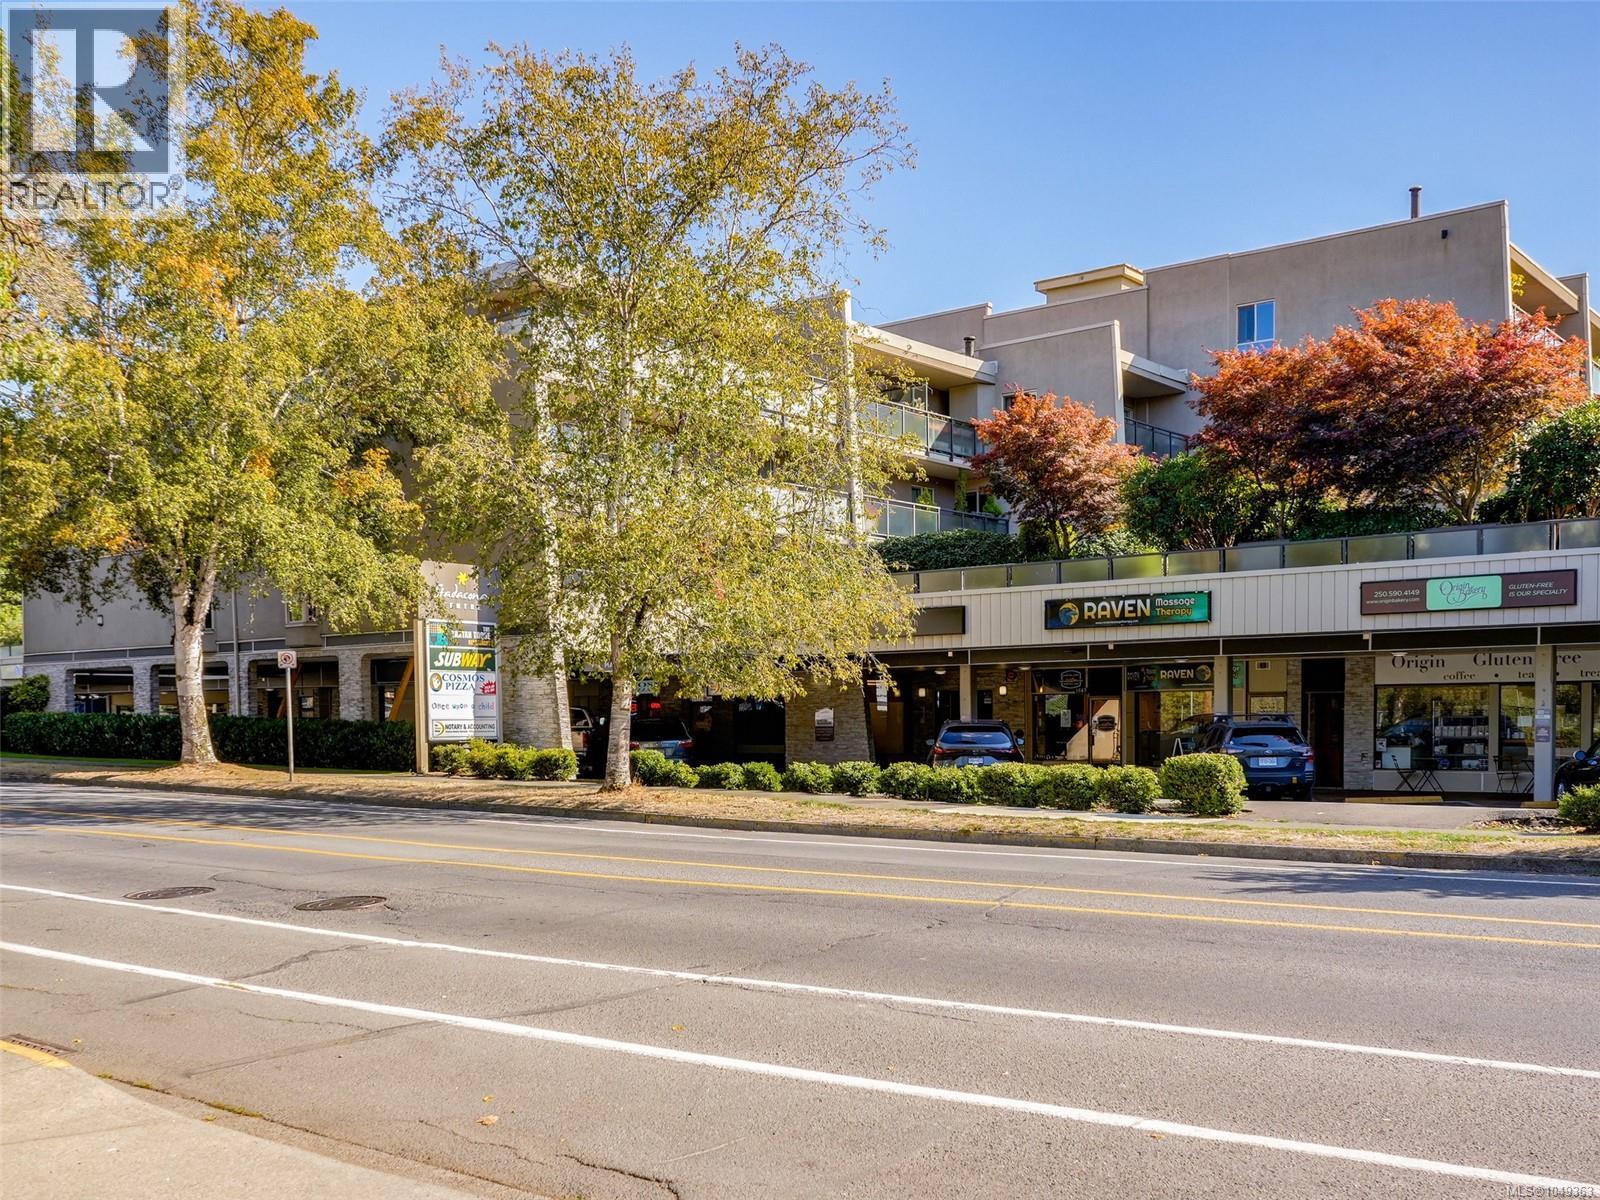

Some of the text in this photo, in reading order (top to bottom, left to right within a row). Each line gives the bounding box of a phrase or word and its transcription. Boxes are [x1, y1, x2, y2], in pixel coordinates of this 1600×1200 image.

[1508, 581, 1554, 590] GLUTEN-FREE
[1373, 589, 1420, 598] 250.590.4149
[1535, 588, 1569, 596] SPECIALTY
[1155, 597, 1195, 606] Massage
[1083, 599, 1150, 619] RAVEN
[1155, 607, 1193, 616] Therapy
[433, 652, 492, 667] SUBWAY
[1391, 652, 1581, 673] Origin Gluten ree
[442, 673, 486, 682] COSMOS
[1160, 669, 1194, 679] RAVEN
[1443, 671, 1476, 681] coffee
[1518, 670, 1535, 679] tea
[445, 682, 475, 691] PIZZA
[431, 702, 450, 710] Once
[451, 703, 468, 711] upon
[478, 702, 496, 710] child
